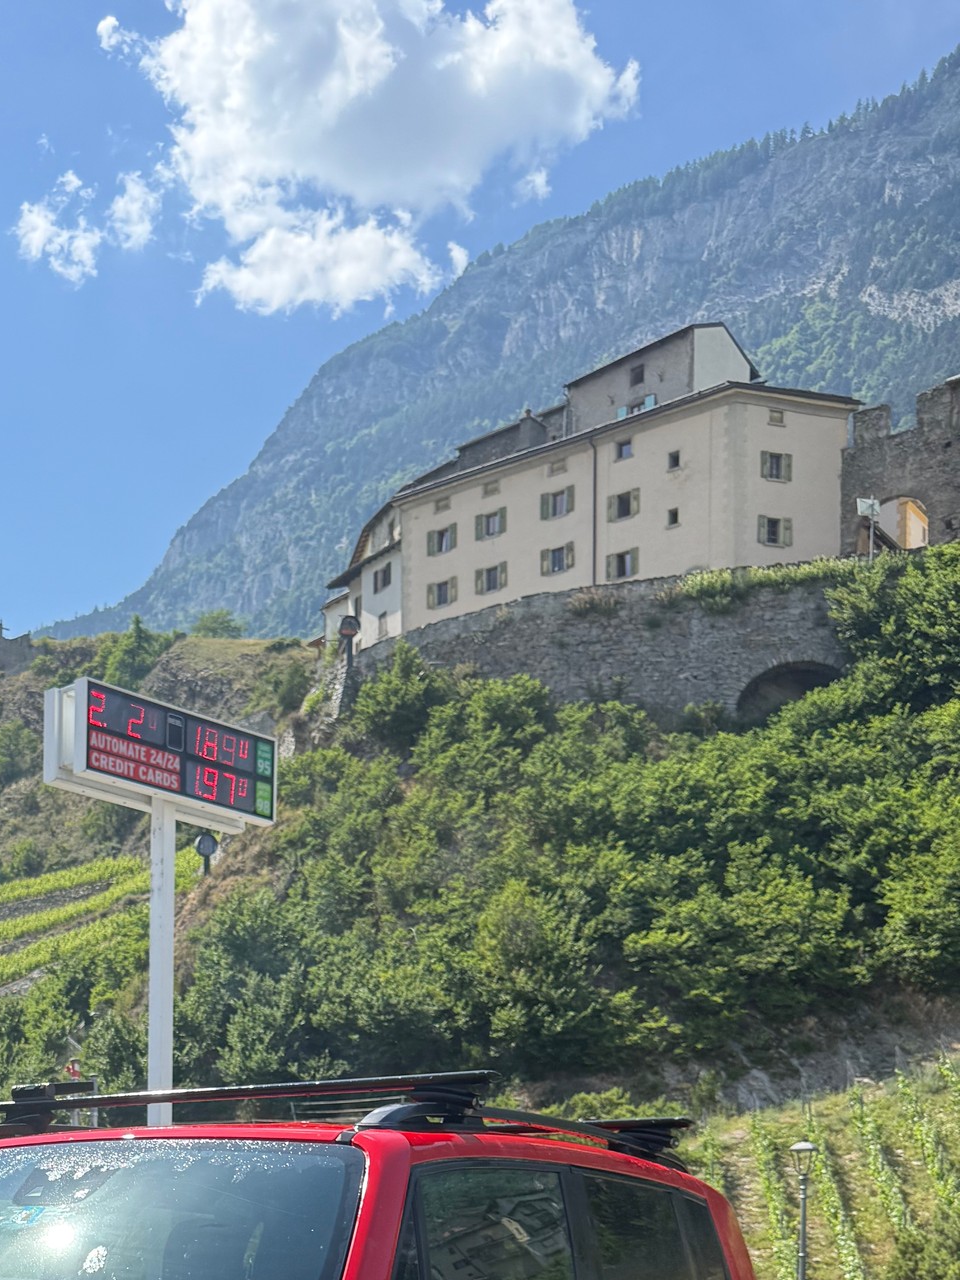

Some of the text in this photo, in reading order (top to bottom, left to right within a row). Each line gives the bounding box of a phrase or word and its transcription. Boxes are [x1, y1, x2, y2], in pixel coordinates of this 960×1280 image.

[91, 732, 180, 771] AUTOMATE 24/24
[91, 752, 178, 789] CREDIT CARDS
[257, 759, 271, 776] 95
[257, 798, 271, 813] 98
